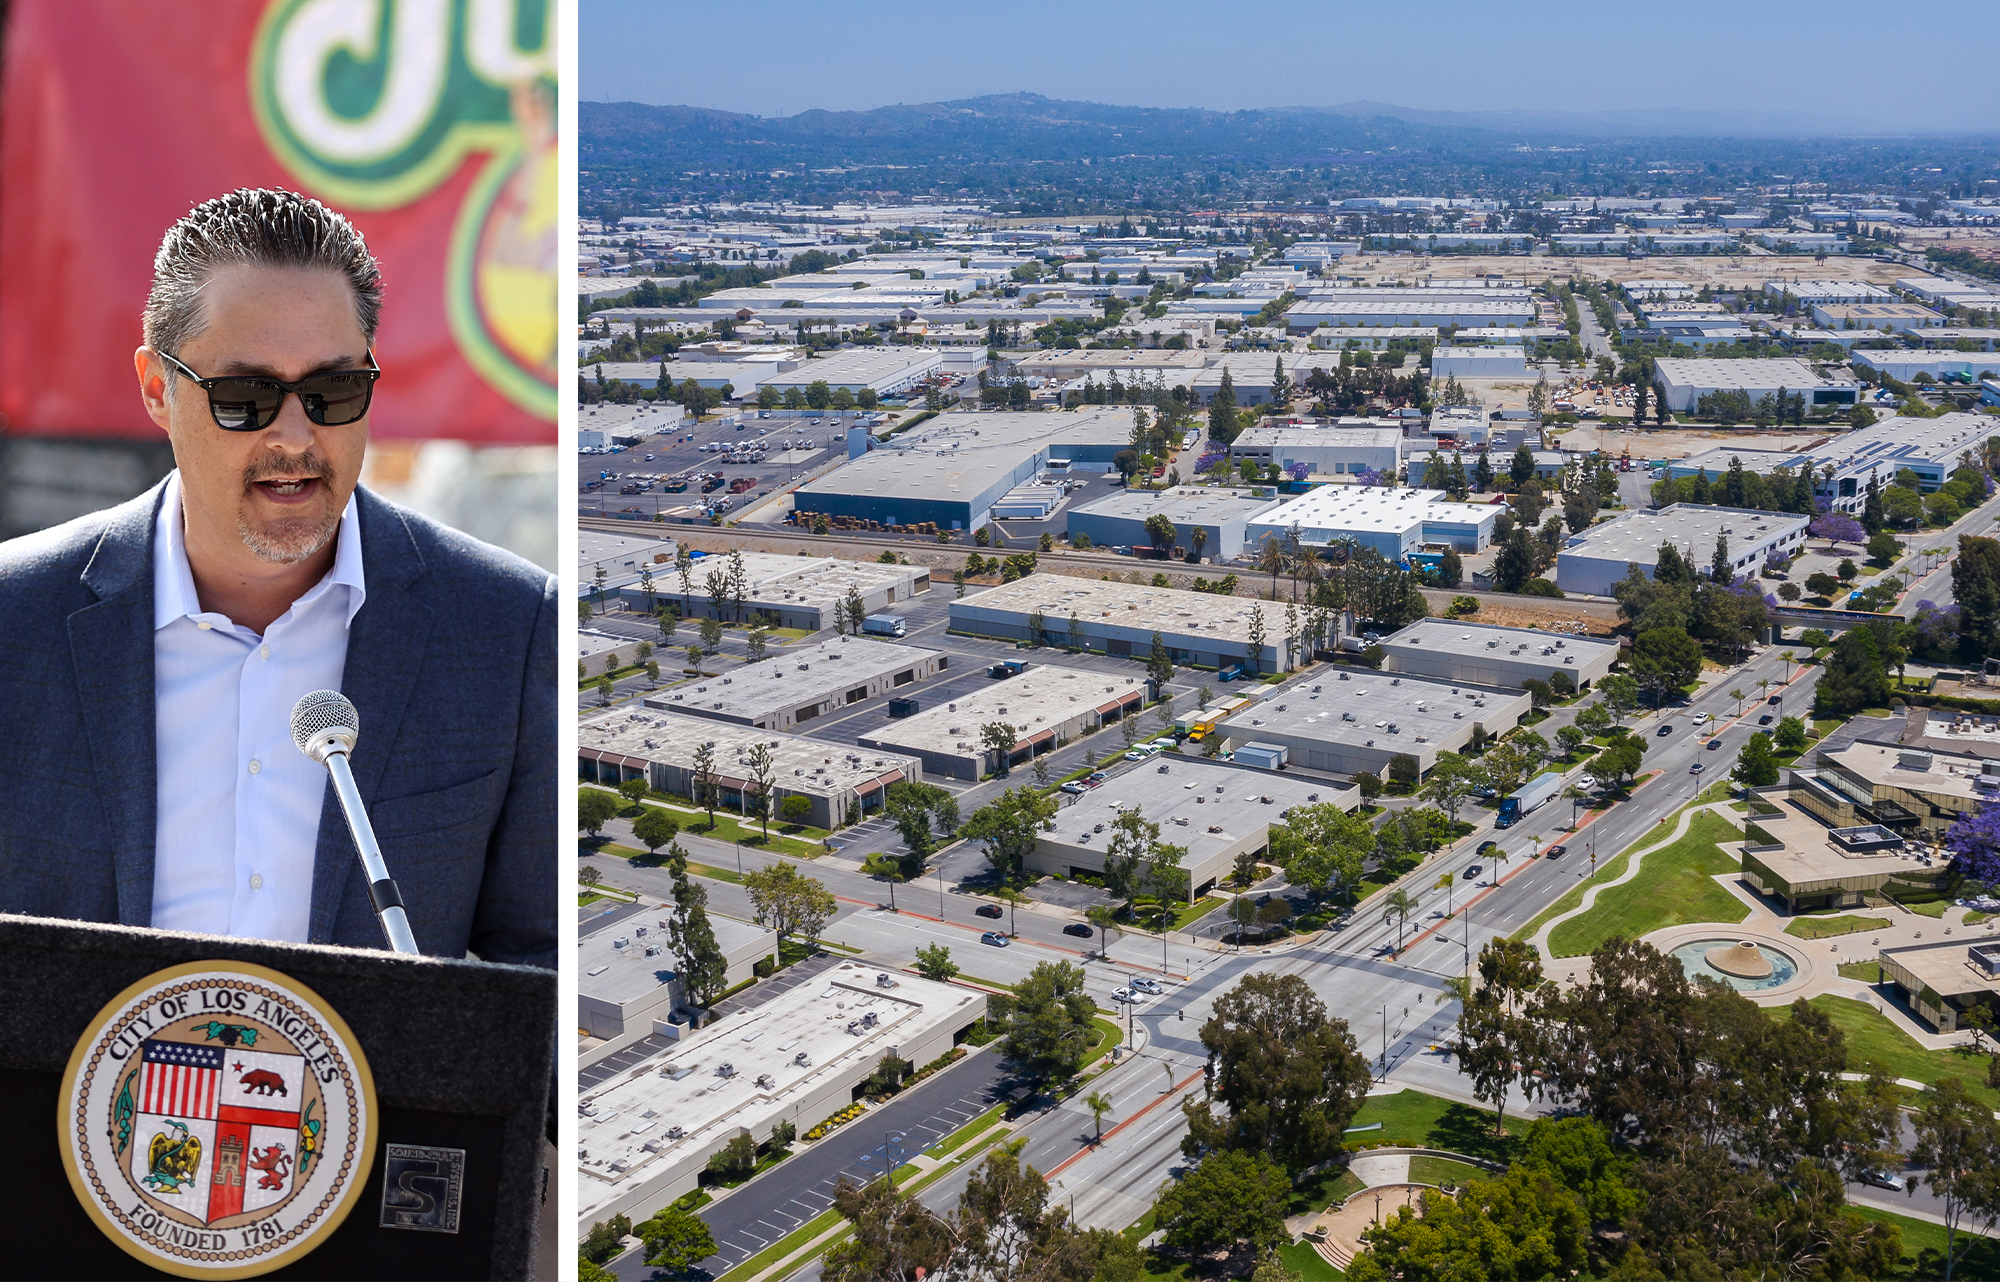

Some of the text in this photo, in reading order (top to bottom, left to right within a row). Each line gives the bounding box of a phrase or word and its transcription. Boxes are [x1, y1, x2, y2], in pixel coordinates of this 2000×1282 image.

[109, 989, 339, 1084] CITY OF LOS ANGELES
[128, 1203, 285, 1251] FOUNDED 1781
